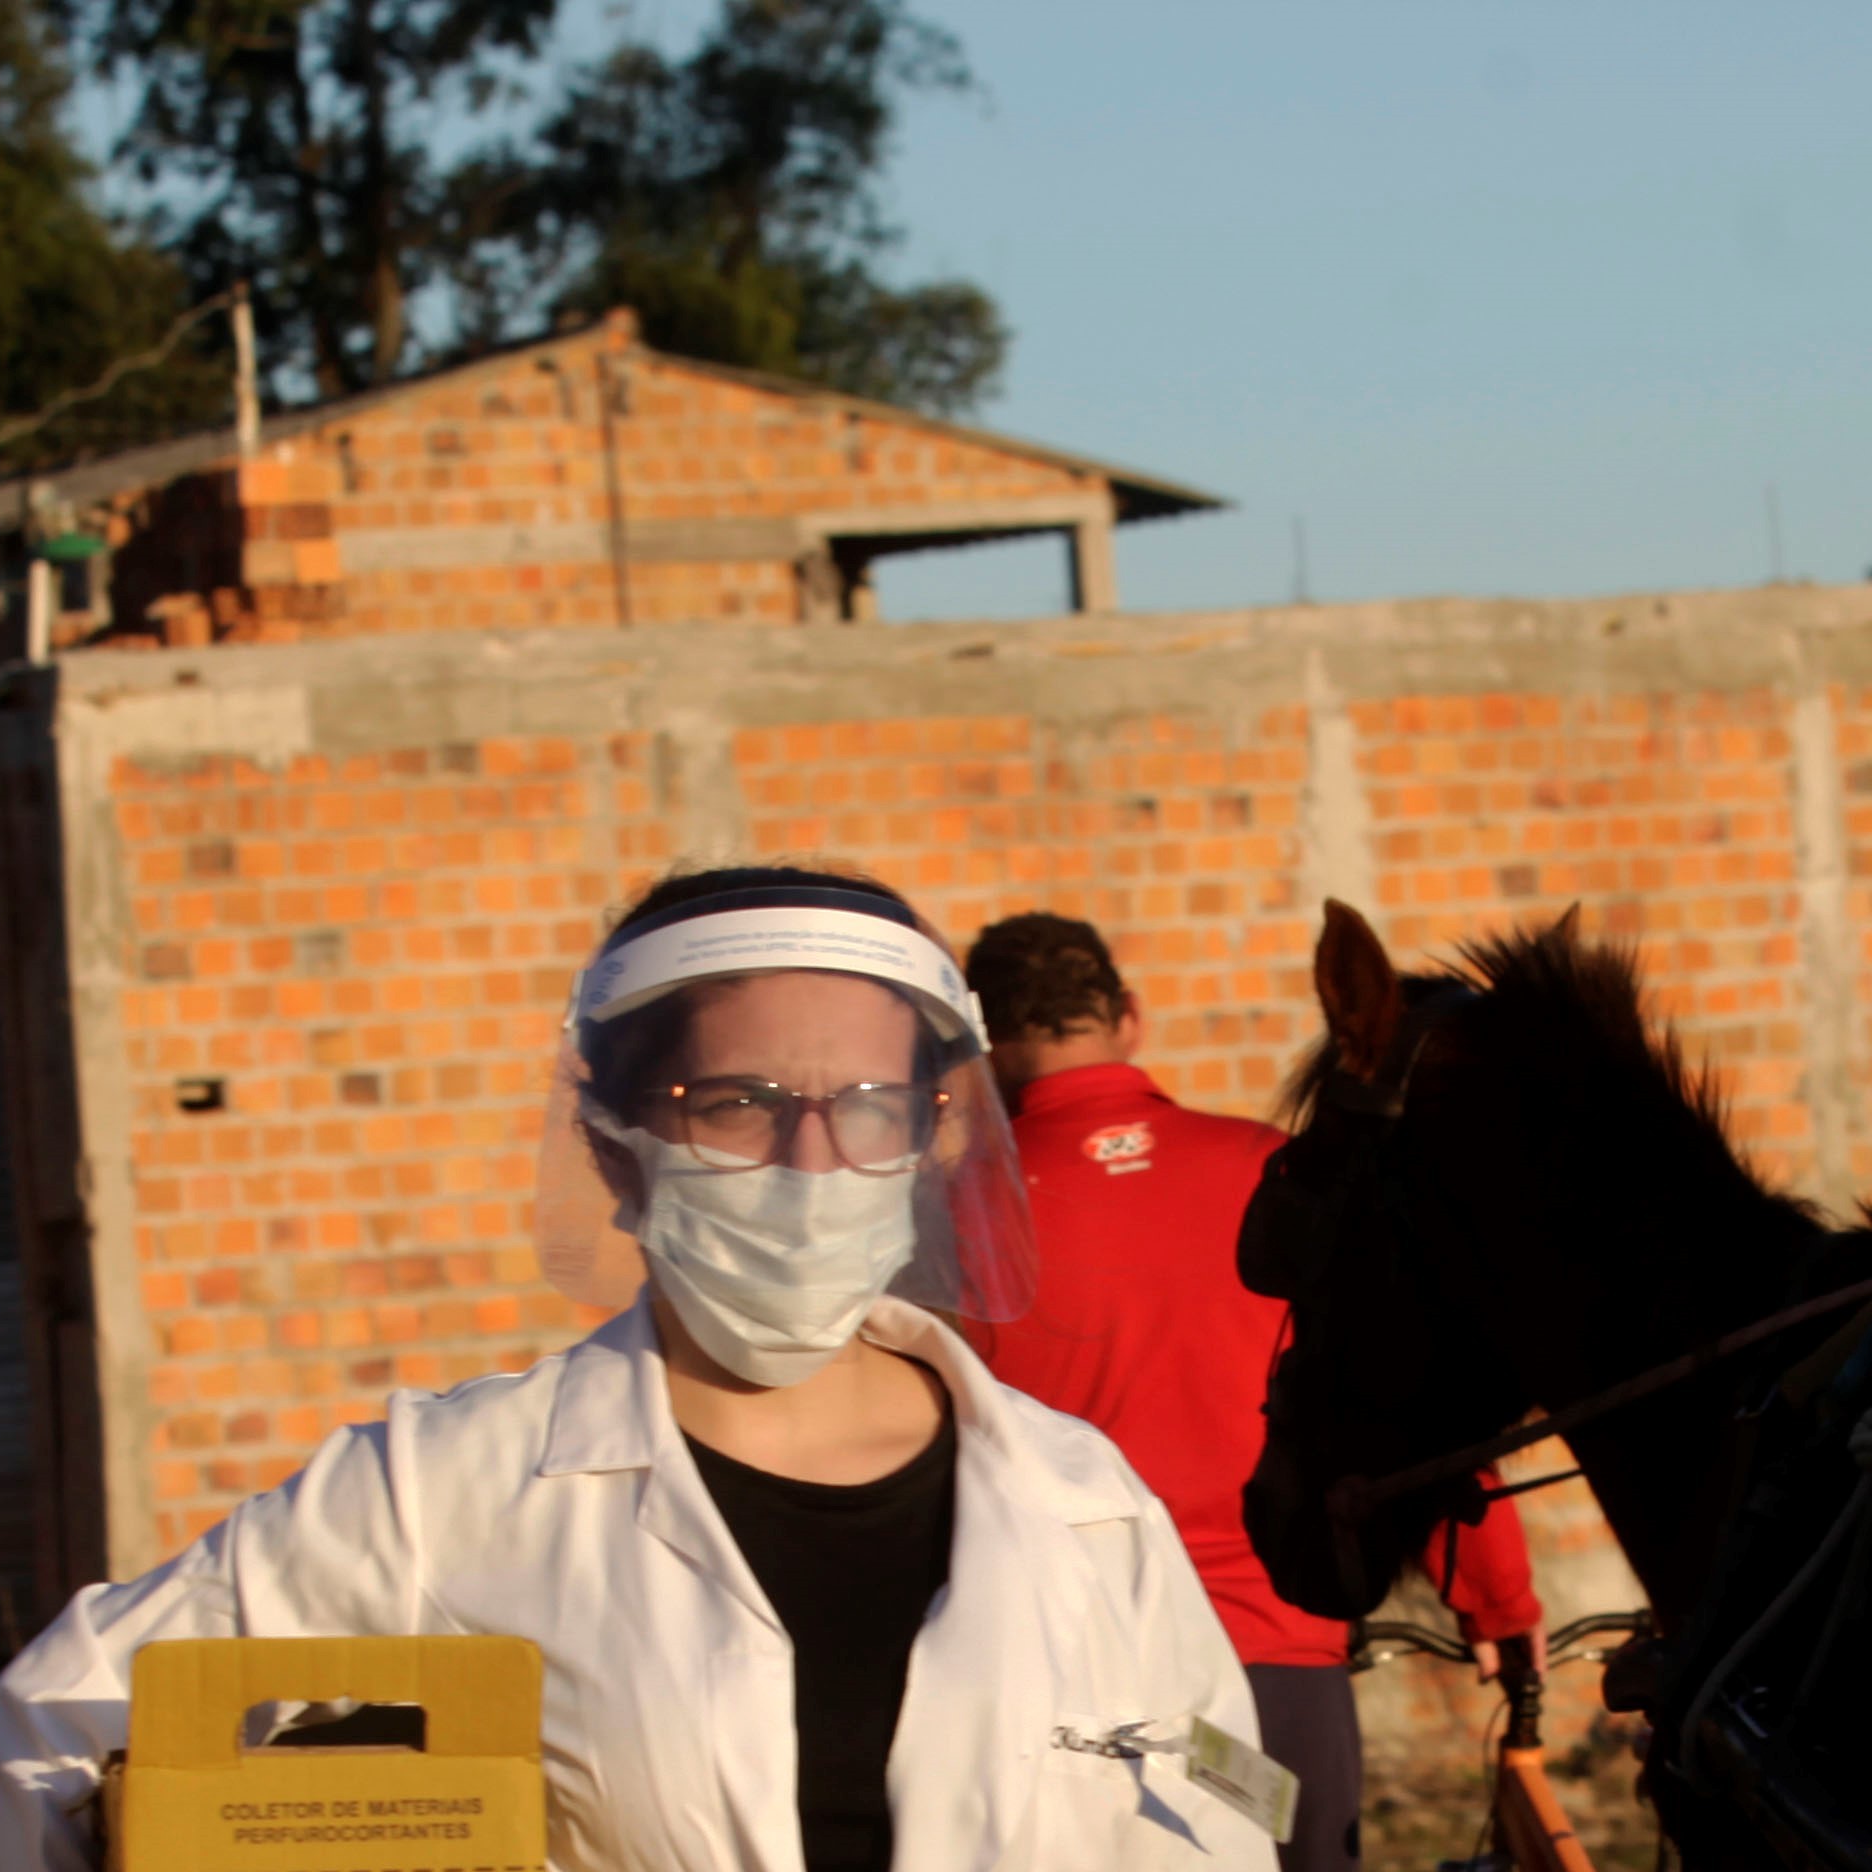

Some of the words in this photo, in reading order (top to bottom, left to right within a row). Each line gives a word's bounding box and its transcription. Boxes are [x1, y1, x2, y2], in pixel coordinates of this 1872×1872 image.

[220, 1801, 324, 1821] COLETOR
[331, 1800, 359, 1818] DE
[367, 1797, 483, 1817] MATERIAIS
[233, 1822, 472, 1844] PERFUROCORTANTES
